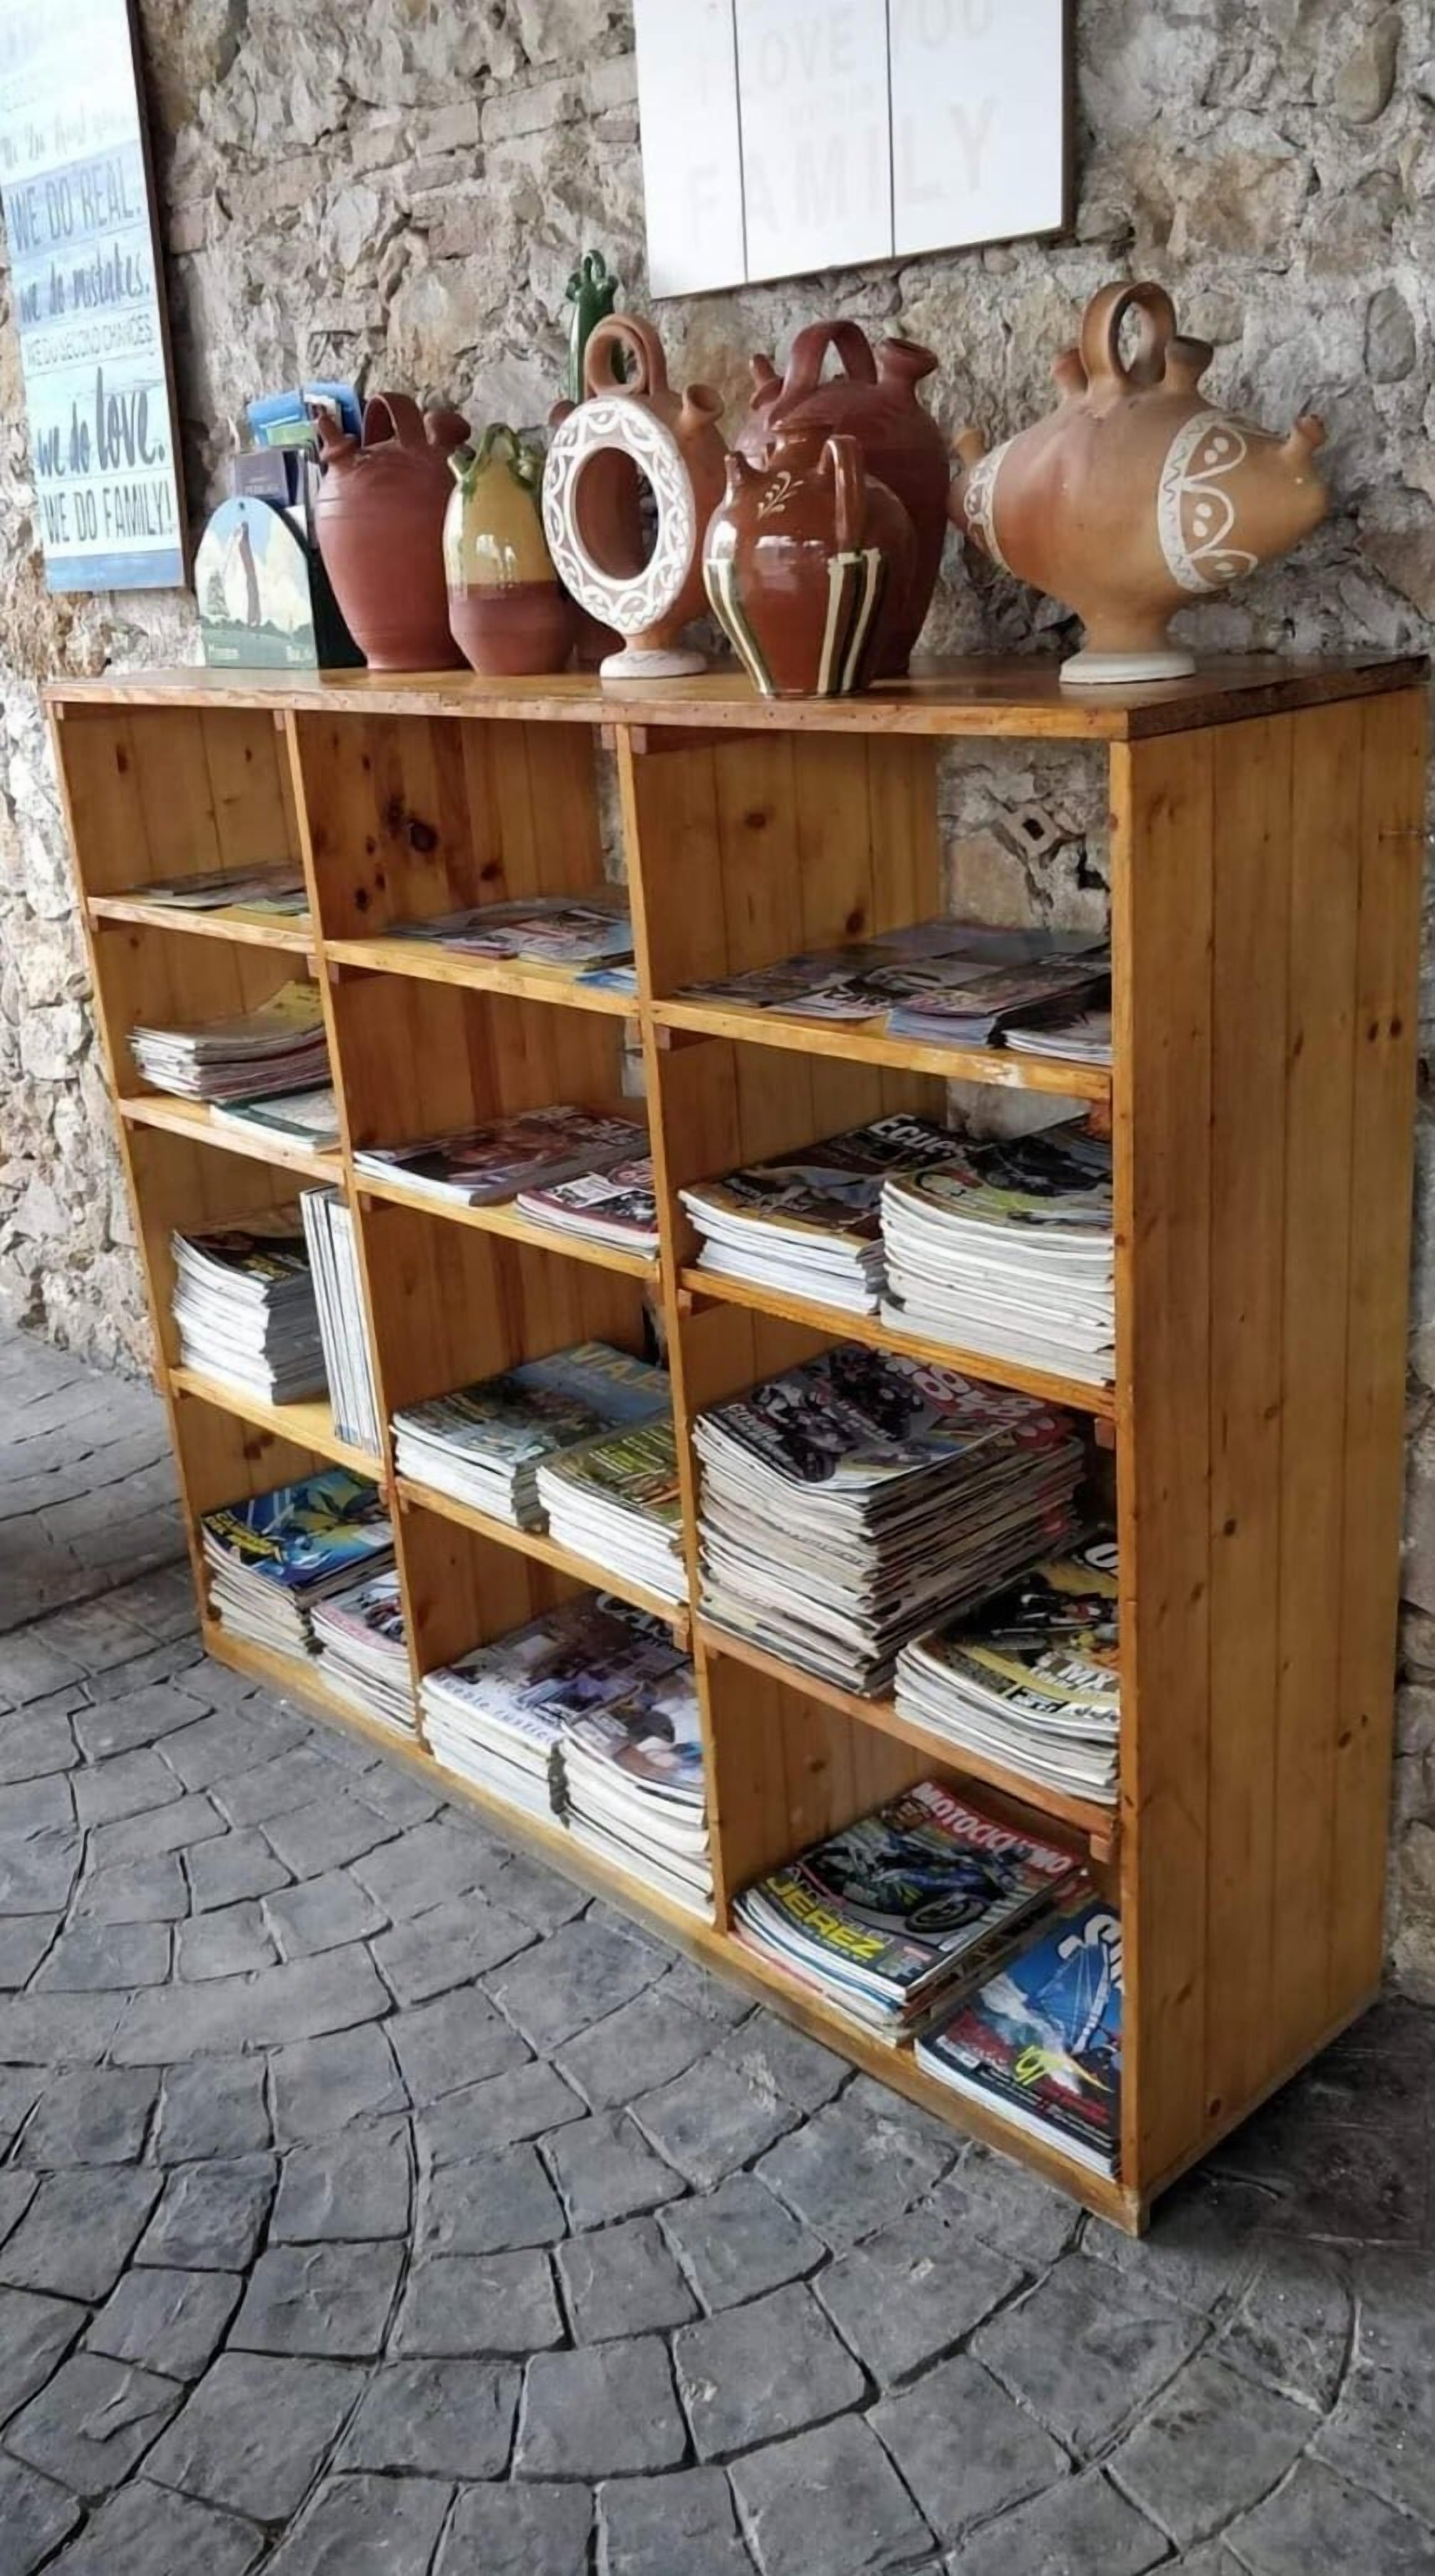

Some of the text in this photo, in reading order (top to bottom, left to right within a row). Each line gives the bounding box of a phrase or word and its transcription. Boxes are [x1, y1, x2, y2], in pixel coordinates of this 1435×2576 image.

[10, 187, 41, 251] WE
[46, 177, 72, 239] DO
[37, 426, 65, 478] we
[69, 401, 91, 474] do
[43, 481, 174, 544] WE DO FAMILY!
[912, 1781, 1073, 1874] MOTOCICLMO
[765, 1876, 885, 1960] JEREZ
